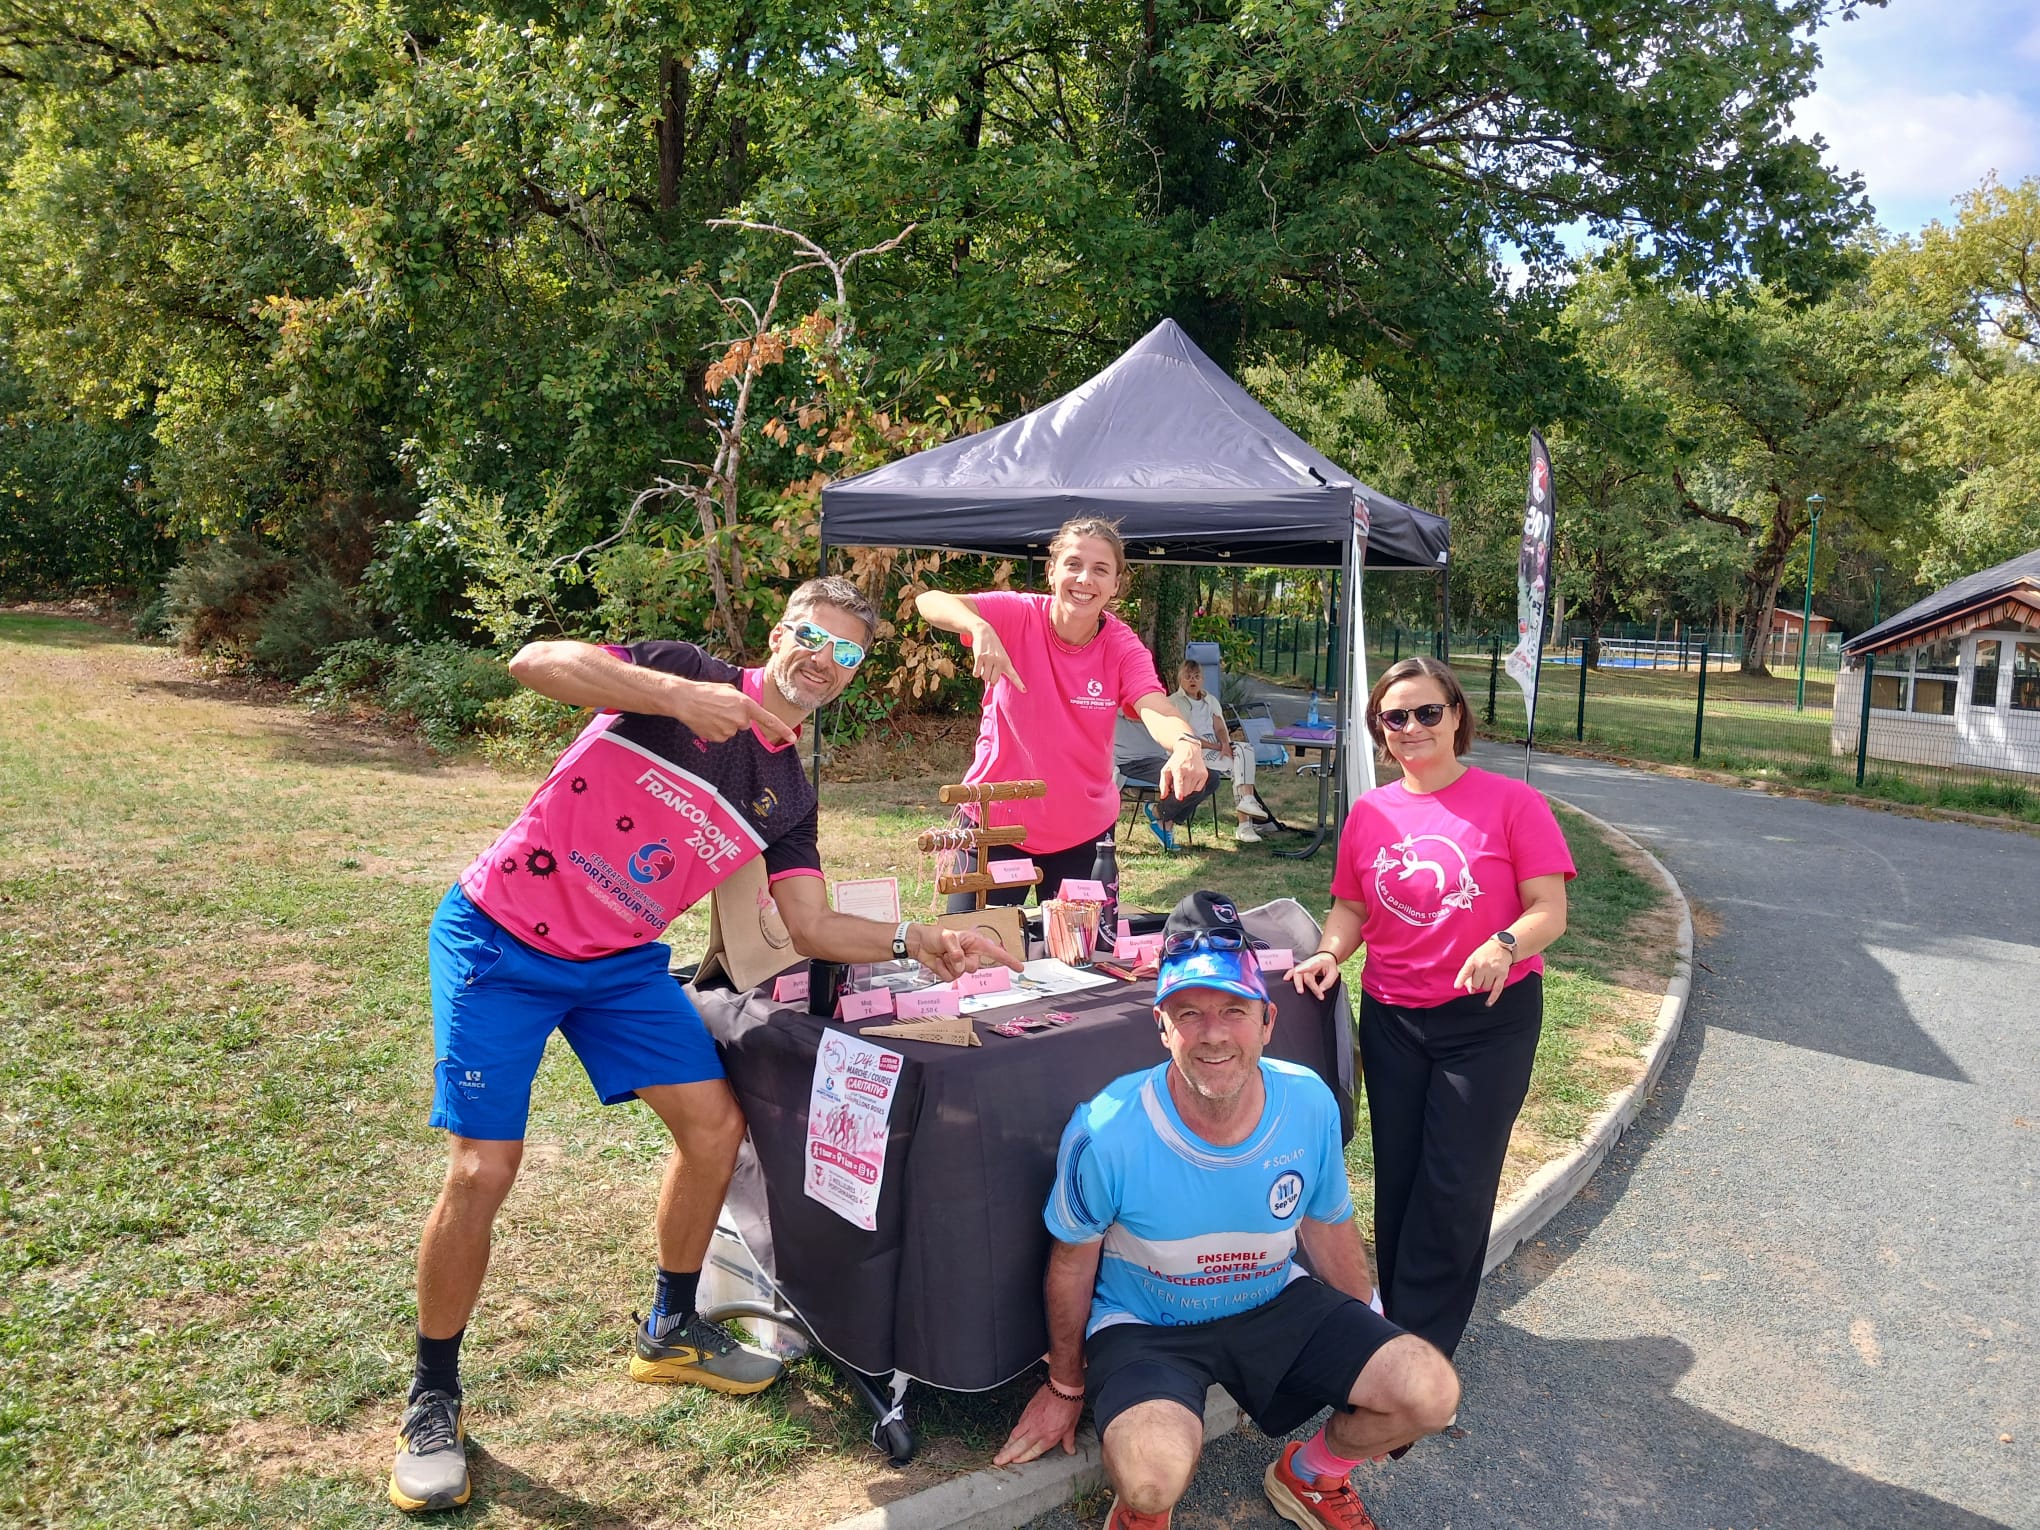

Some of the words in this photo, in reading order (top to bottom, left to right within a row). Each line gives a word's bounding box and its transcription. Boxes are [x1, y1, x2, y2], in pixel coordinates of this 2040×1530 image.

[568, 850, 612, 889] SPORTS
[610, 886, 642, 914] POUR
[640, 908, 666, 930] TOUS
[1379, 880, 1389, 896] Les
[1387, 896, 1426, 919] papillons
[847, 1066, 868, 1079] MARCHE
[871, 1072, 893, 1087] COURSE
[848, 1078, 885, 1097] CARITATIVE
[1197, 1251, 1268, 1265] ENSEMBLE
[1203, 1262, 1259, 1275] CONTRE
[1166, 1272, 1231, 1287] SCLEROSE
[1233, 1272, 1251, 1282] EN
